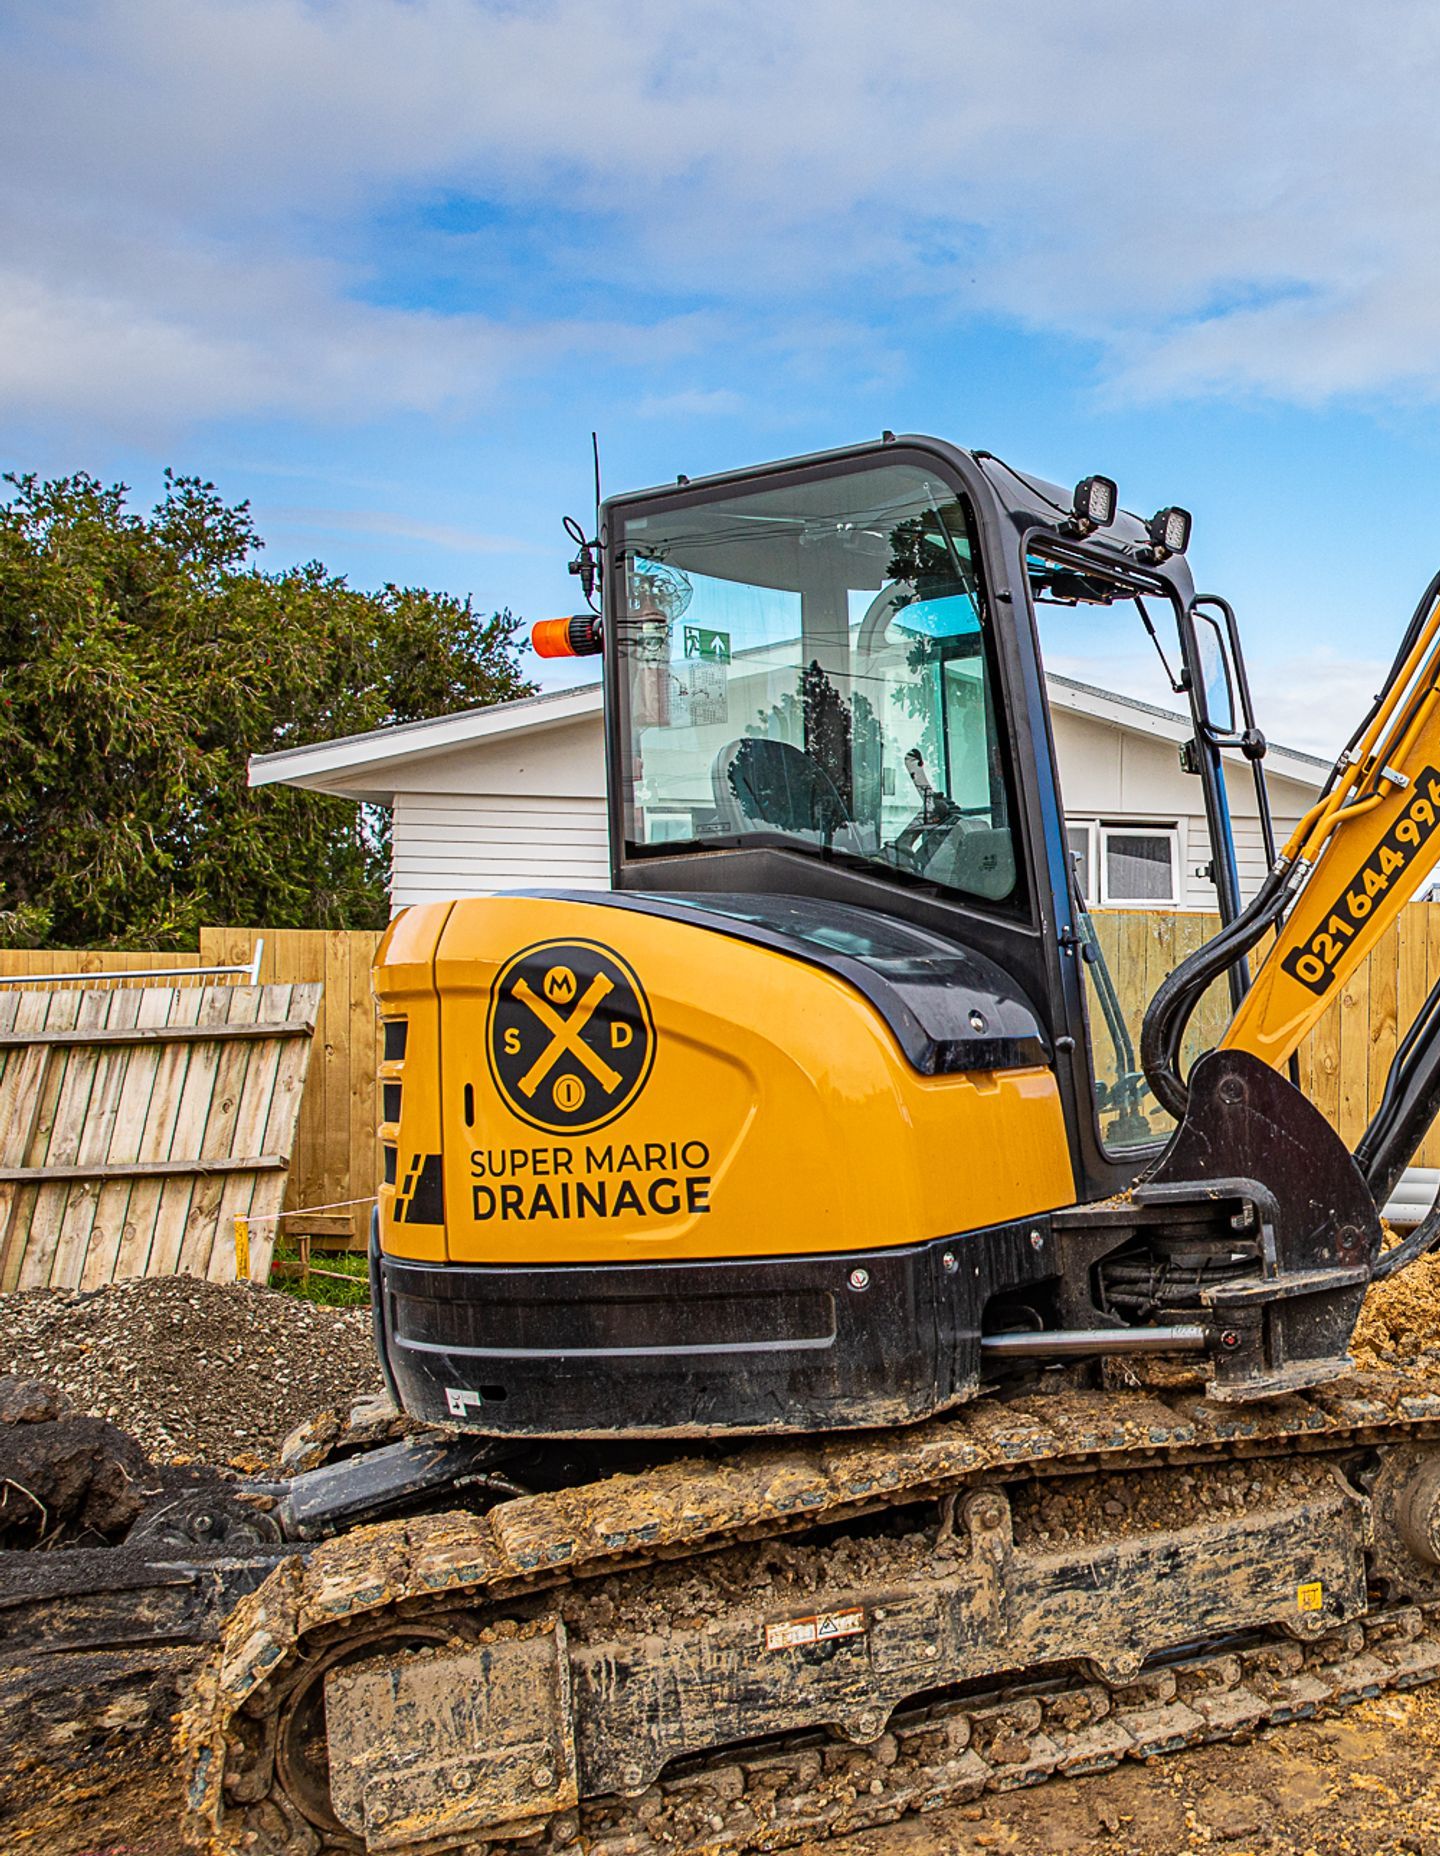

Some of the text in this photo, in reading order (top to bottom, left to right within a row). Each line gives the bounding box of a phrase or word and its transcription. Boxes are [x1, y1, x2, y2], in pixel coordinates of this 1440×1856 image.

[1296, 914, 1355, 983] 021
[1346, 846, 1405, 918] 644
[548, 973, 573, 996] M
[503, 1027, 521, 1055] S
[610, 1021, 634, 1049] D
[470, 1140, 710, 1177] SUPER MARIO
[472, 1176, 712, 1221] DRAINAGE
